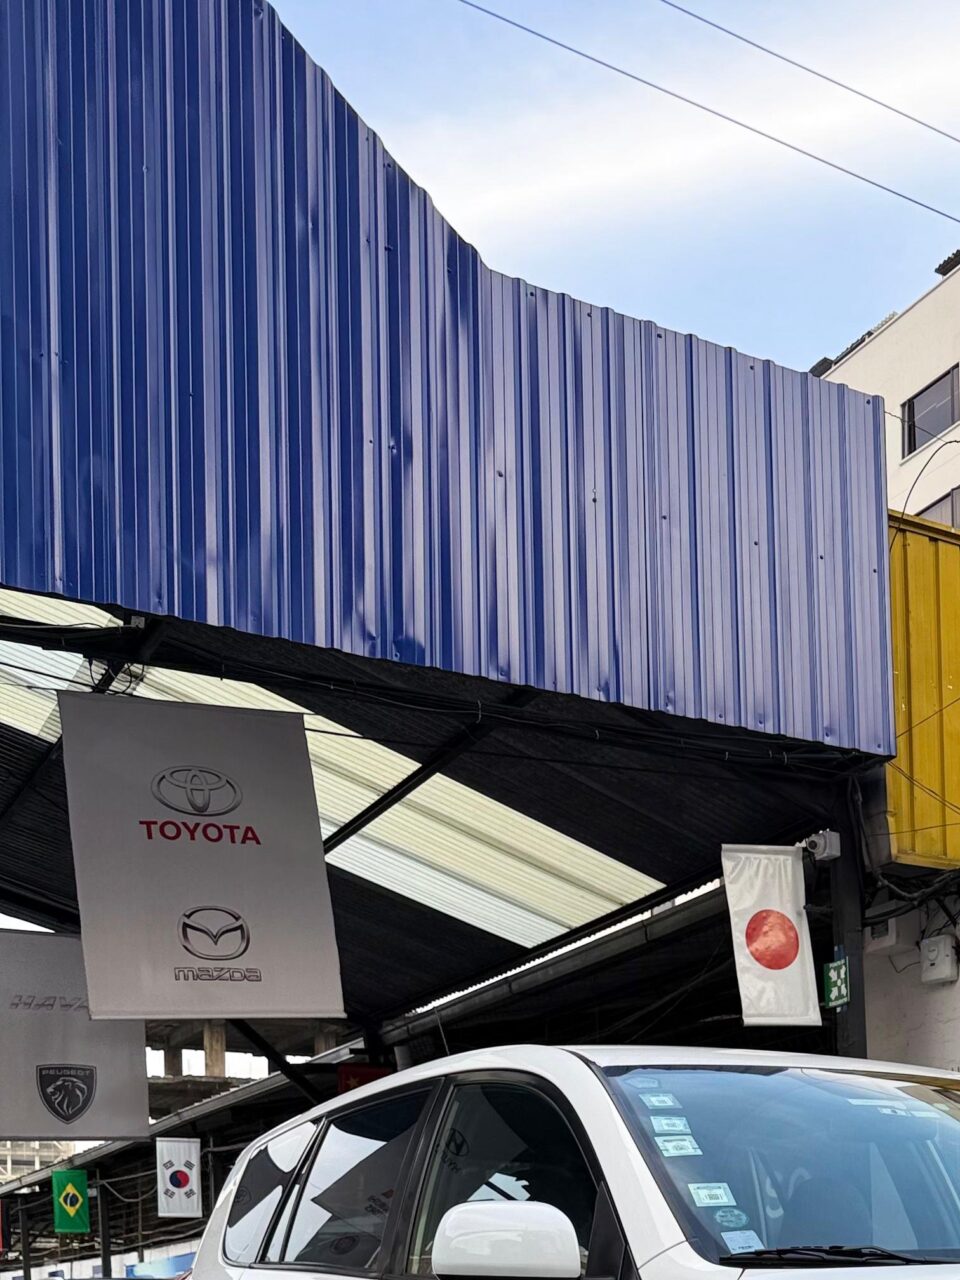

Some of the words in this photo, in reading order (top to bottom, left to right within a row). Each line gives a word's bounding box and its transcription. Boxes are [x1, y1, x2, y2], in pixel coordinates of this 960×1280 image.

[139, 820, 262, 846] TOYOTA
[173, 966, 263, 983] mazda
[41, 1068, 92, 1077] PEUGEOT
